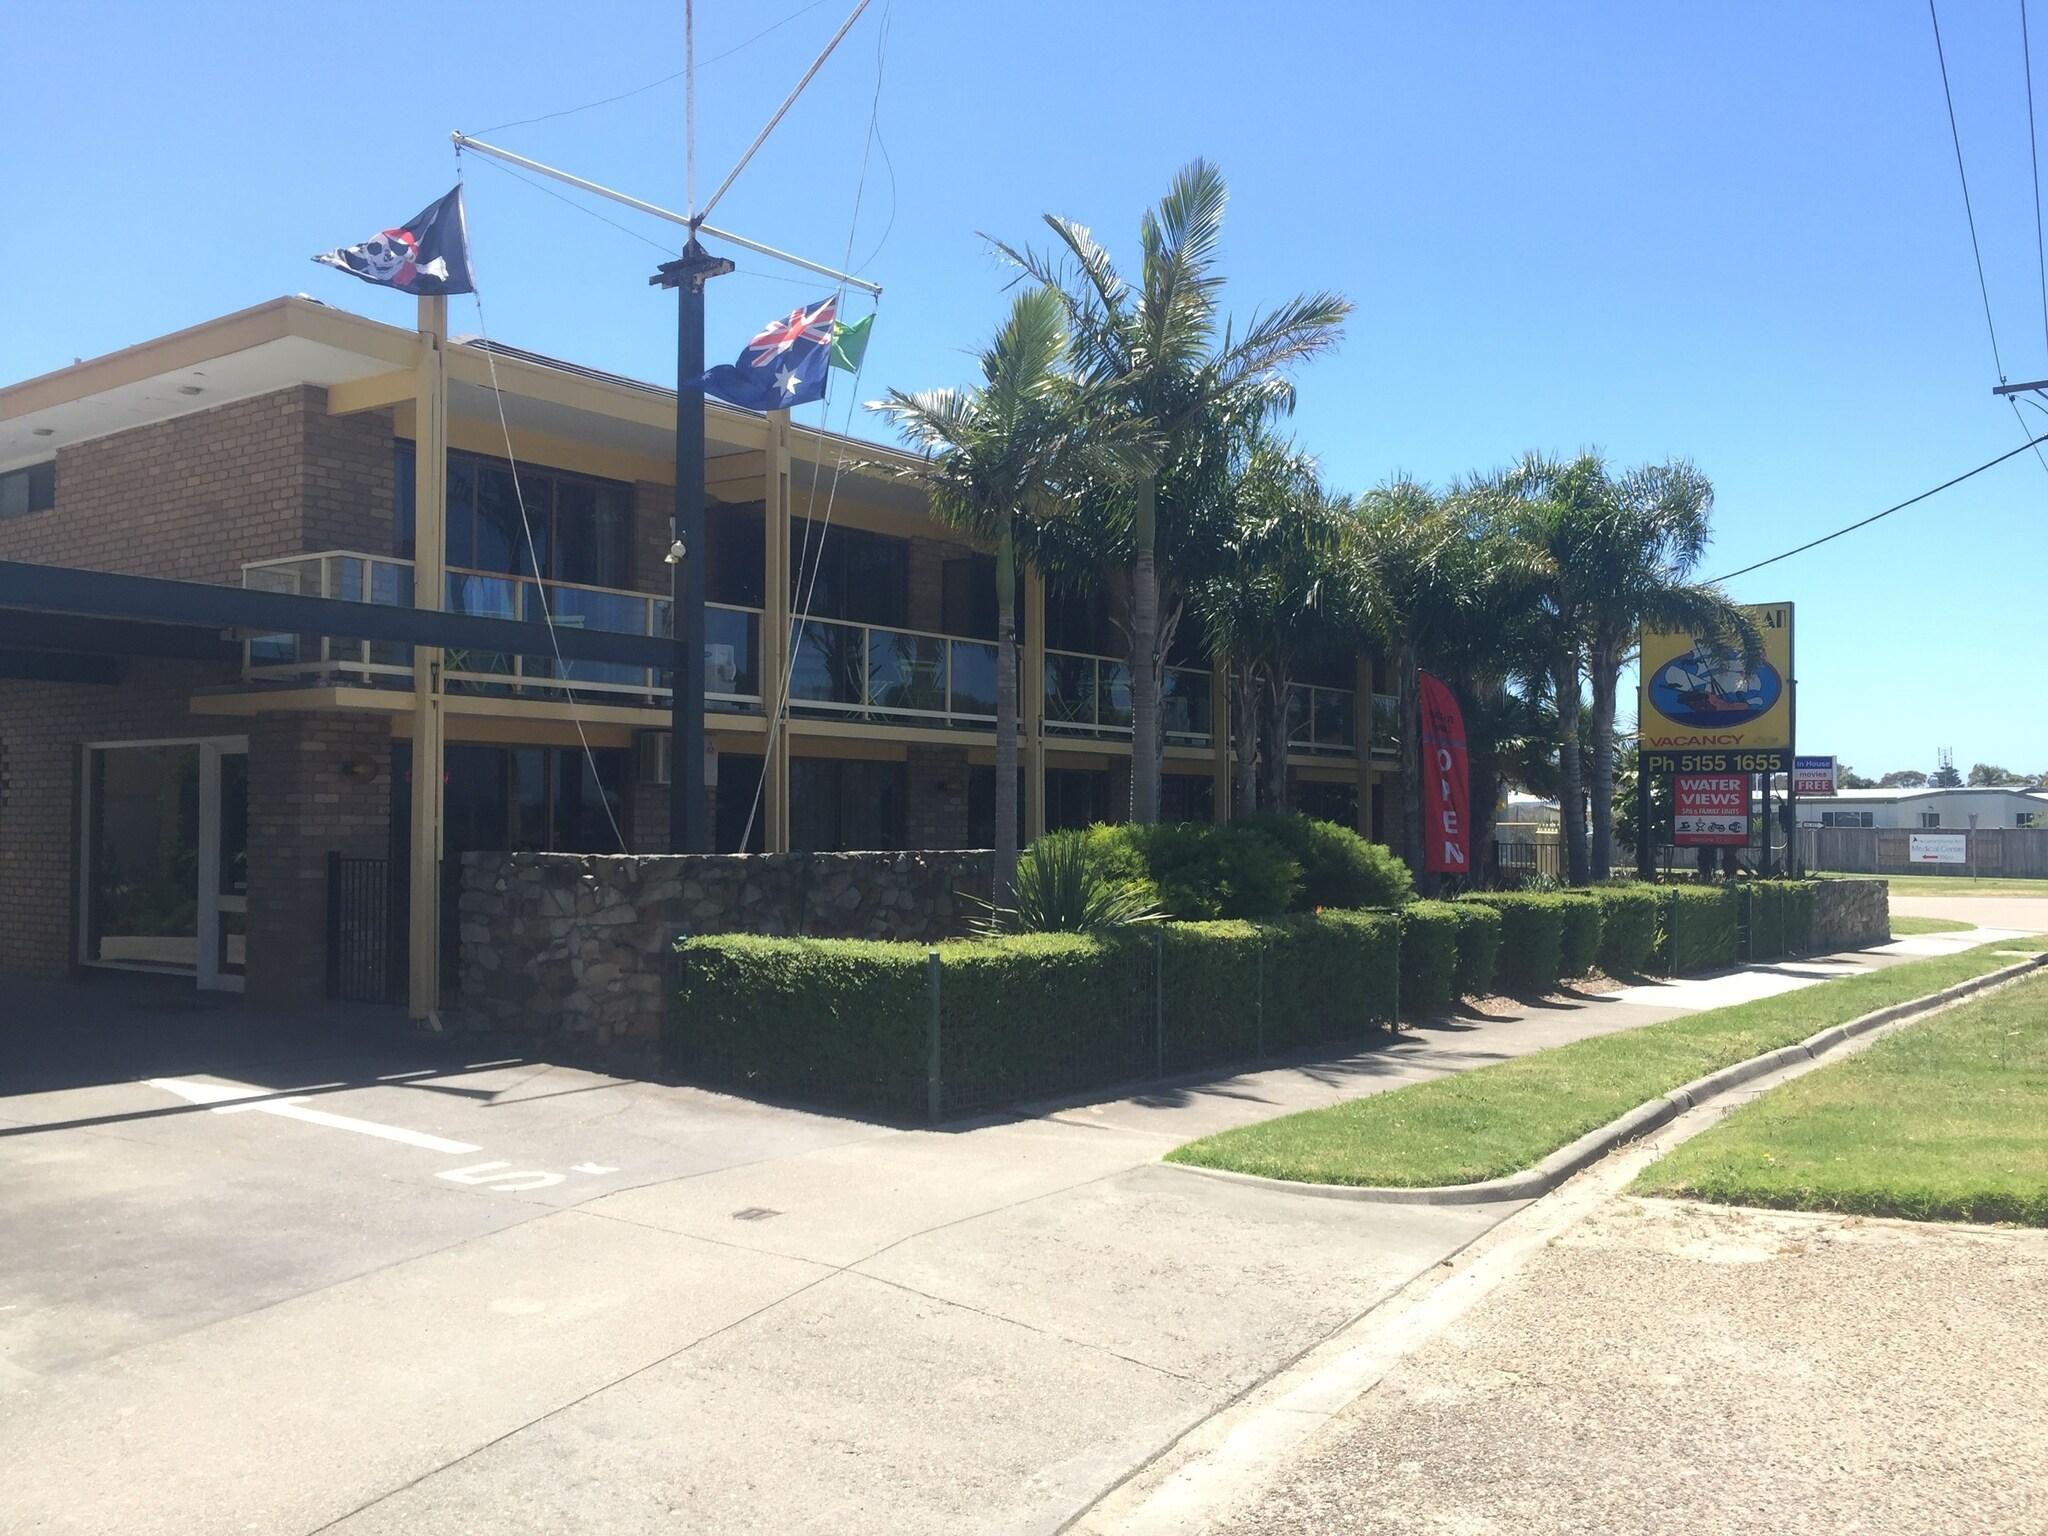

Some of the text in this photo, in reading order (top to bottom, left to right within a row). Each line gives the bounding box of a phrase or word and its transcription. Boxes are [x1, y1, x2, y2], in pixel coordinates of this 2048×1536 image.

[1650, 734, 1745, 747] VACANCY
[1649, 754, 1782, 772] Ph 5155 1655
[1806, 760, 1831, 768] House
[1680, 779, 1741, 791] WATER
[1798, 781, 1830, 791] FREE
[1681, 794, 1741, 805] VIEWS
